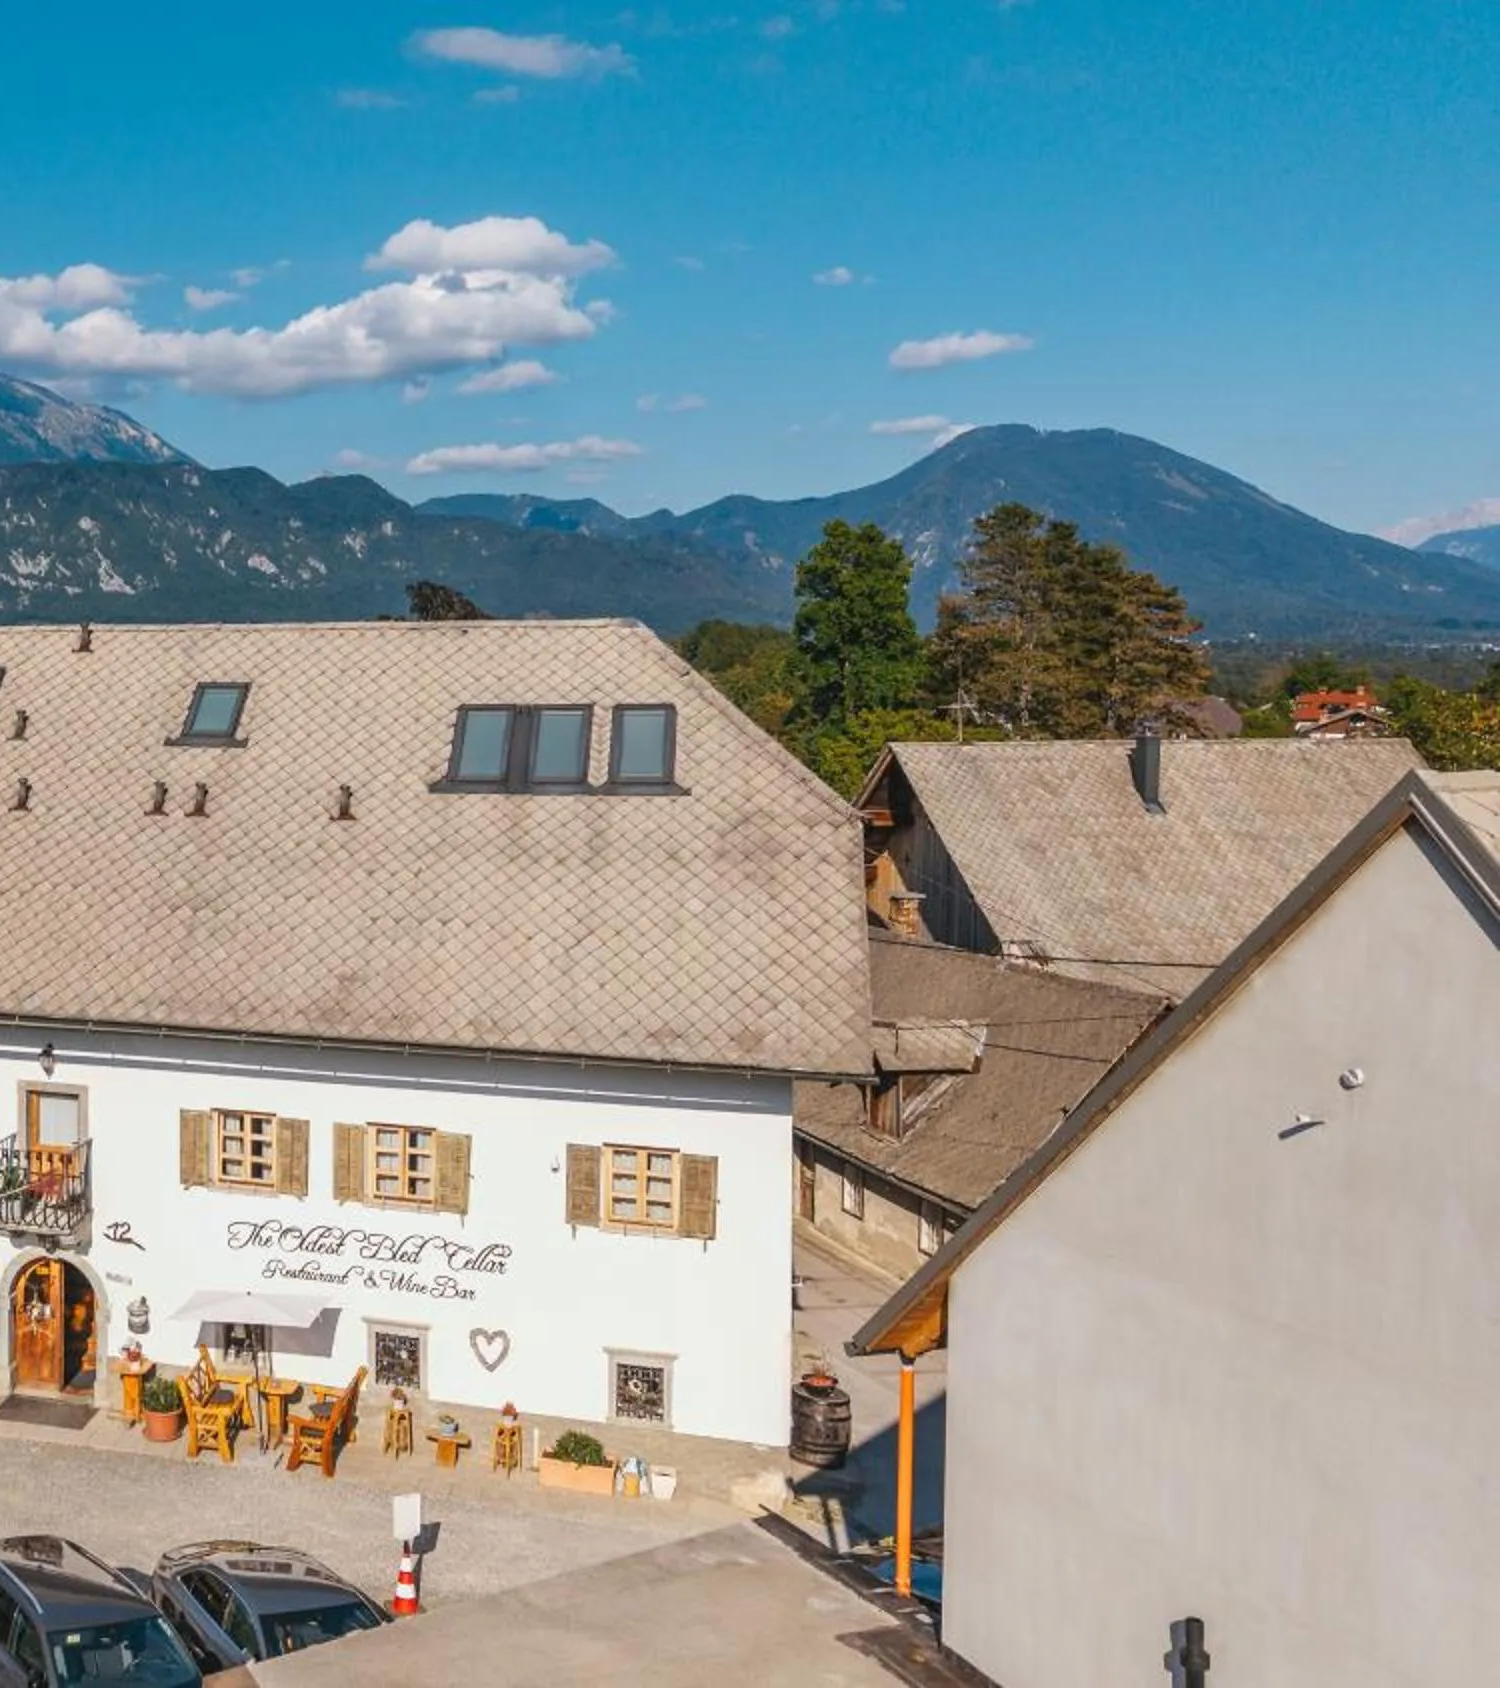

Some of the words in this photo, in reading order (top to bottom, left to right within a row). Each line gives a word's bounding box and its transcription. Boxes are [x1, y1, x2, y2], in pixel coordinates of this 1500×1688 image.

[106, 1221, 131, 1242] 12
[227, 1219, 282, 1249] The
[278, 1225, 366, 1256] Oldest
[360, 1233, 446, 1264] Bled
[445, 1242, 513, 1275] Cellar
[261, 1259, 365, 1285] Restaurant
[363, 1270, 379, 1288] &
[379, 1269, 429, 1295] Wine
[429, 1275, 476, 1300] Bar
